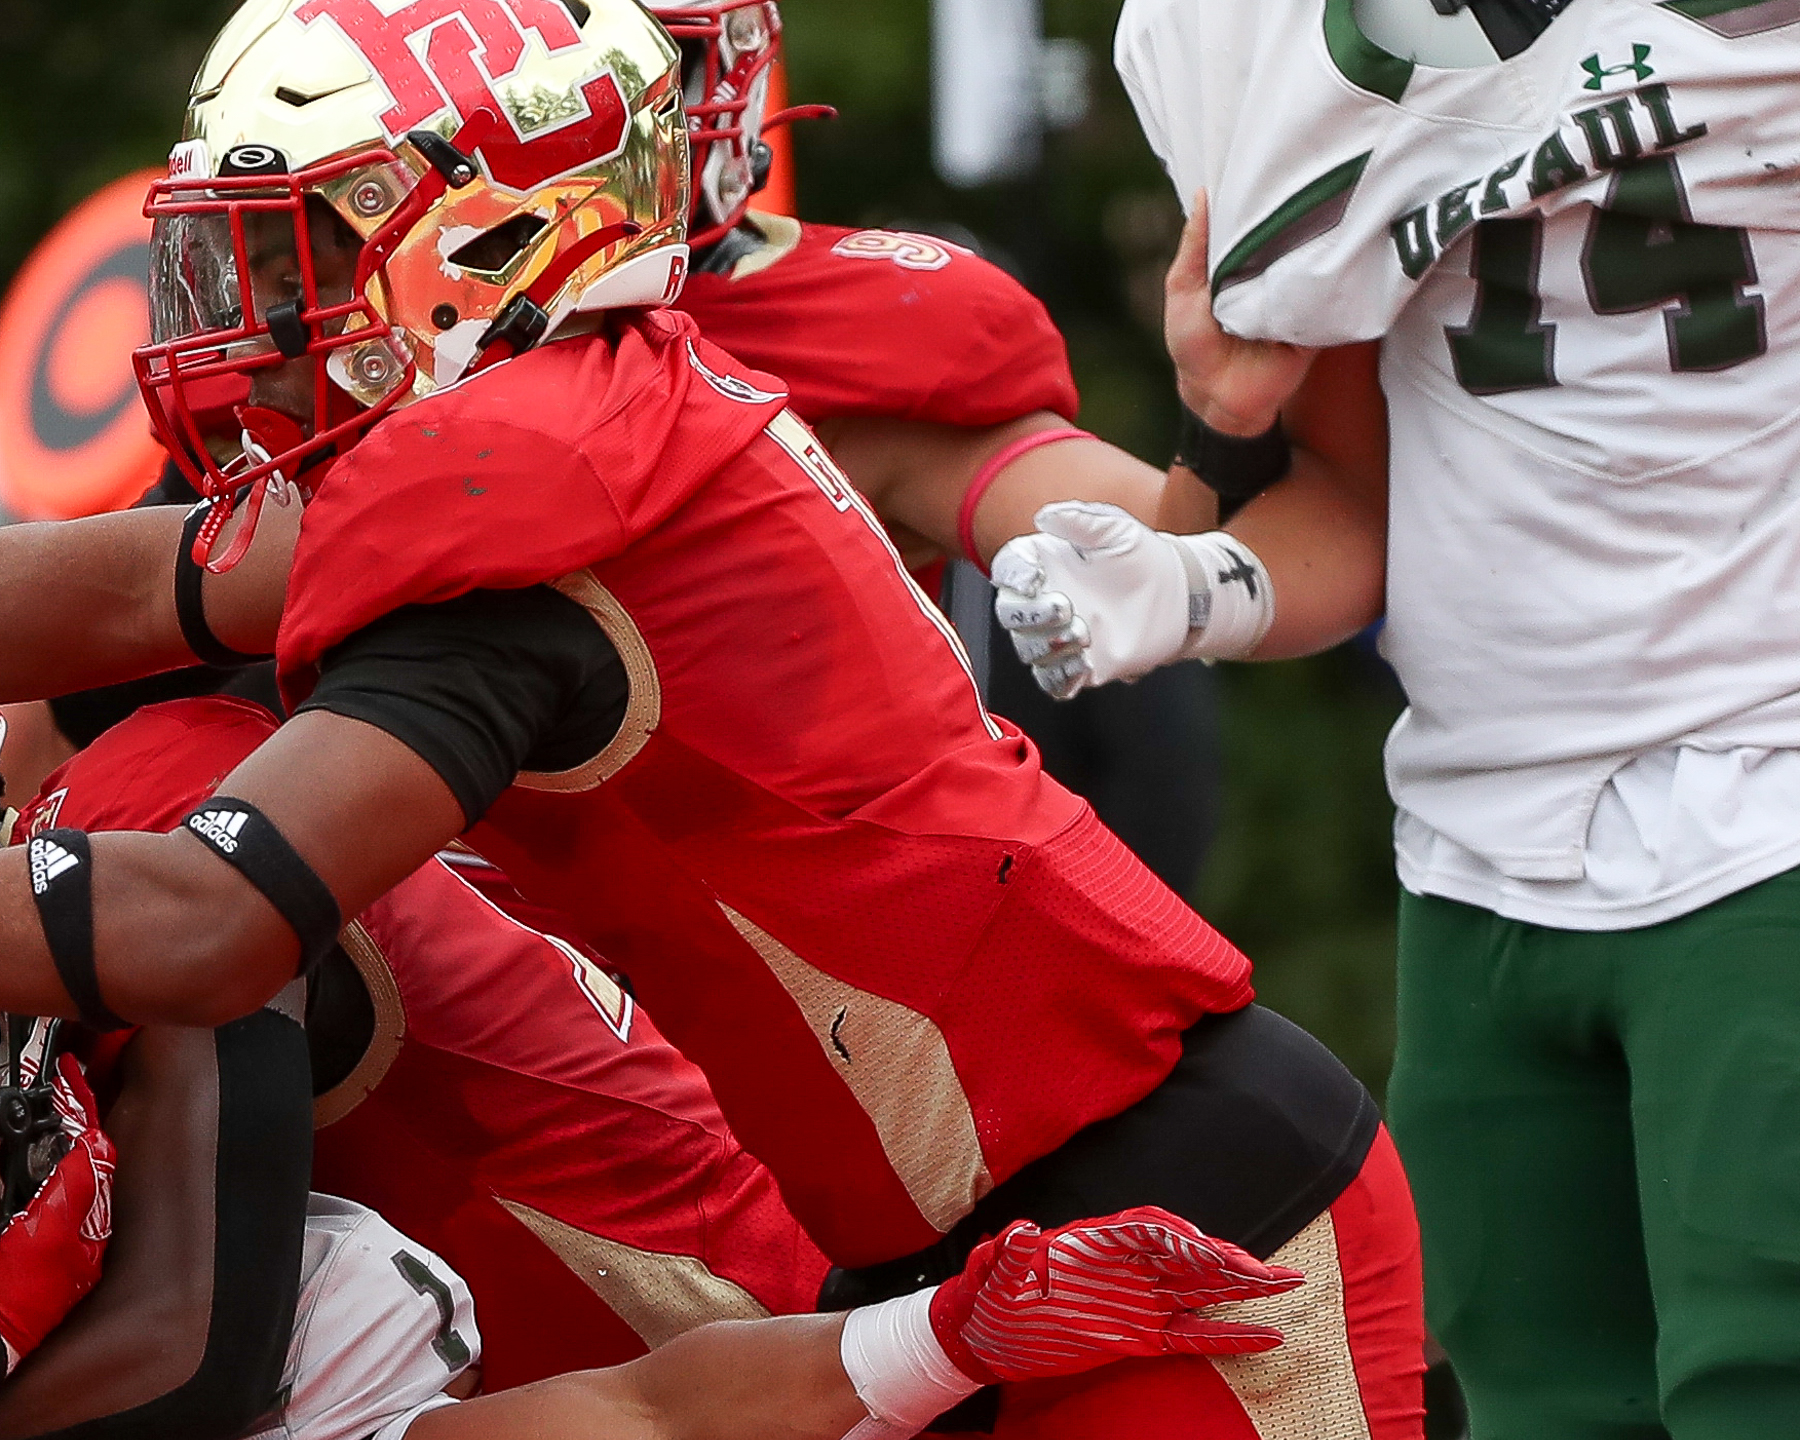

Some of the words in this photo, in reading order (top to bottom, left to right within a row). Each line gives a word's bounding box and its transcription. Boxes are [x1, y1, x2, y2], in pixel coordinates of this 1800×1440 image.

[1443, 152, 1768, 396] 14
[30, 838, 48, 895] adidas
[188, 813, 238, 855] adidas
[390, 1249, 471, 1373] 1
